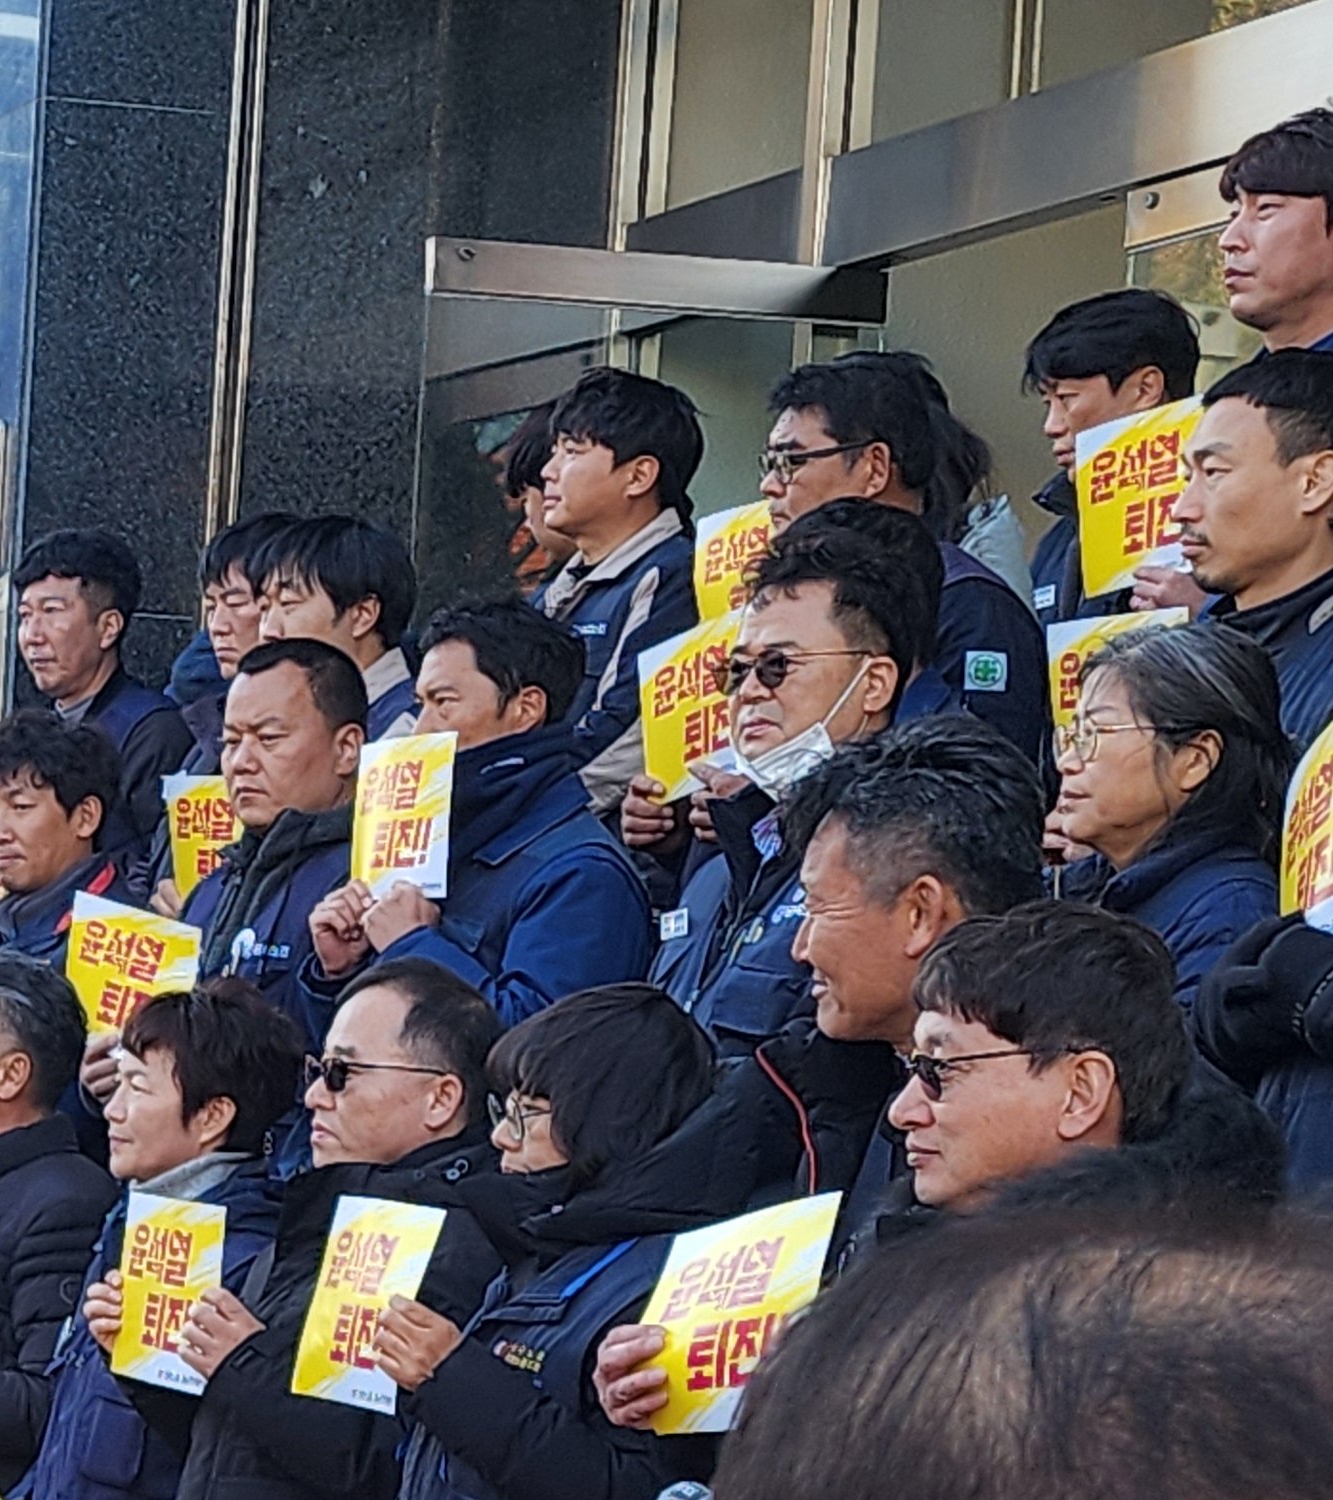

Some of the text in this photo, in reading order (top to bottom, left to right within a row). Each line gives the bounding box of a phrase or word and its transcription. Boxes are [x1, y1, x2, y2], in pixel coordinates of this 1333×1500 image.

[1090, 429, 1181, 506] 윤석열
[1122, 492, 1182, 556] 퇴진
[683, 701, 730, 763] 퇴진
[176, 797, 235, 841] 윤석열
[361, 760, 424, 816] 윤석열
[370, 817, 434, 869] 퇴진!
[79, 919, 167, 985] 윤석열
[128, 1223, 193, 1288] 윤석열
[325, 1230, 401, 1296] 윤석열
[659, 1235, 786, 1324] 윤석열
[141, 1292, 194, 1354] 퇴진
[329, 1303, 383, 1371] 퇴진
[686, 1311, 792, 1393] 퇴진
